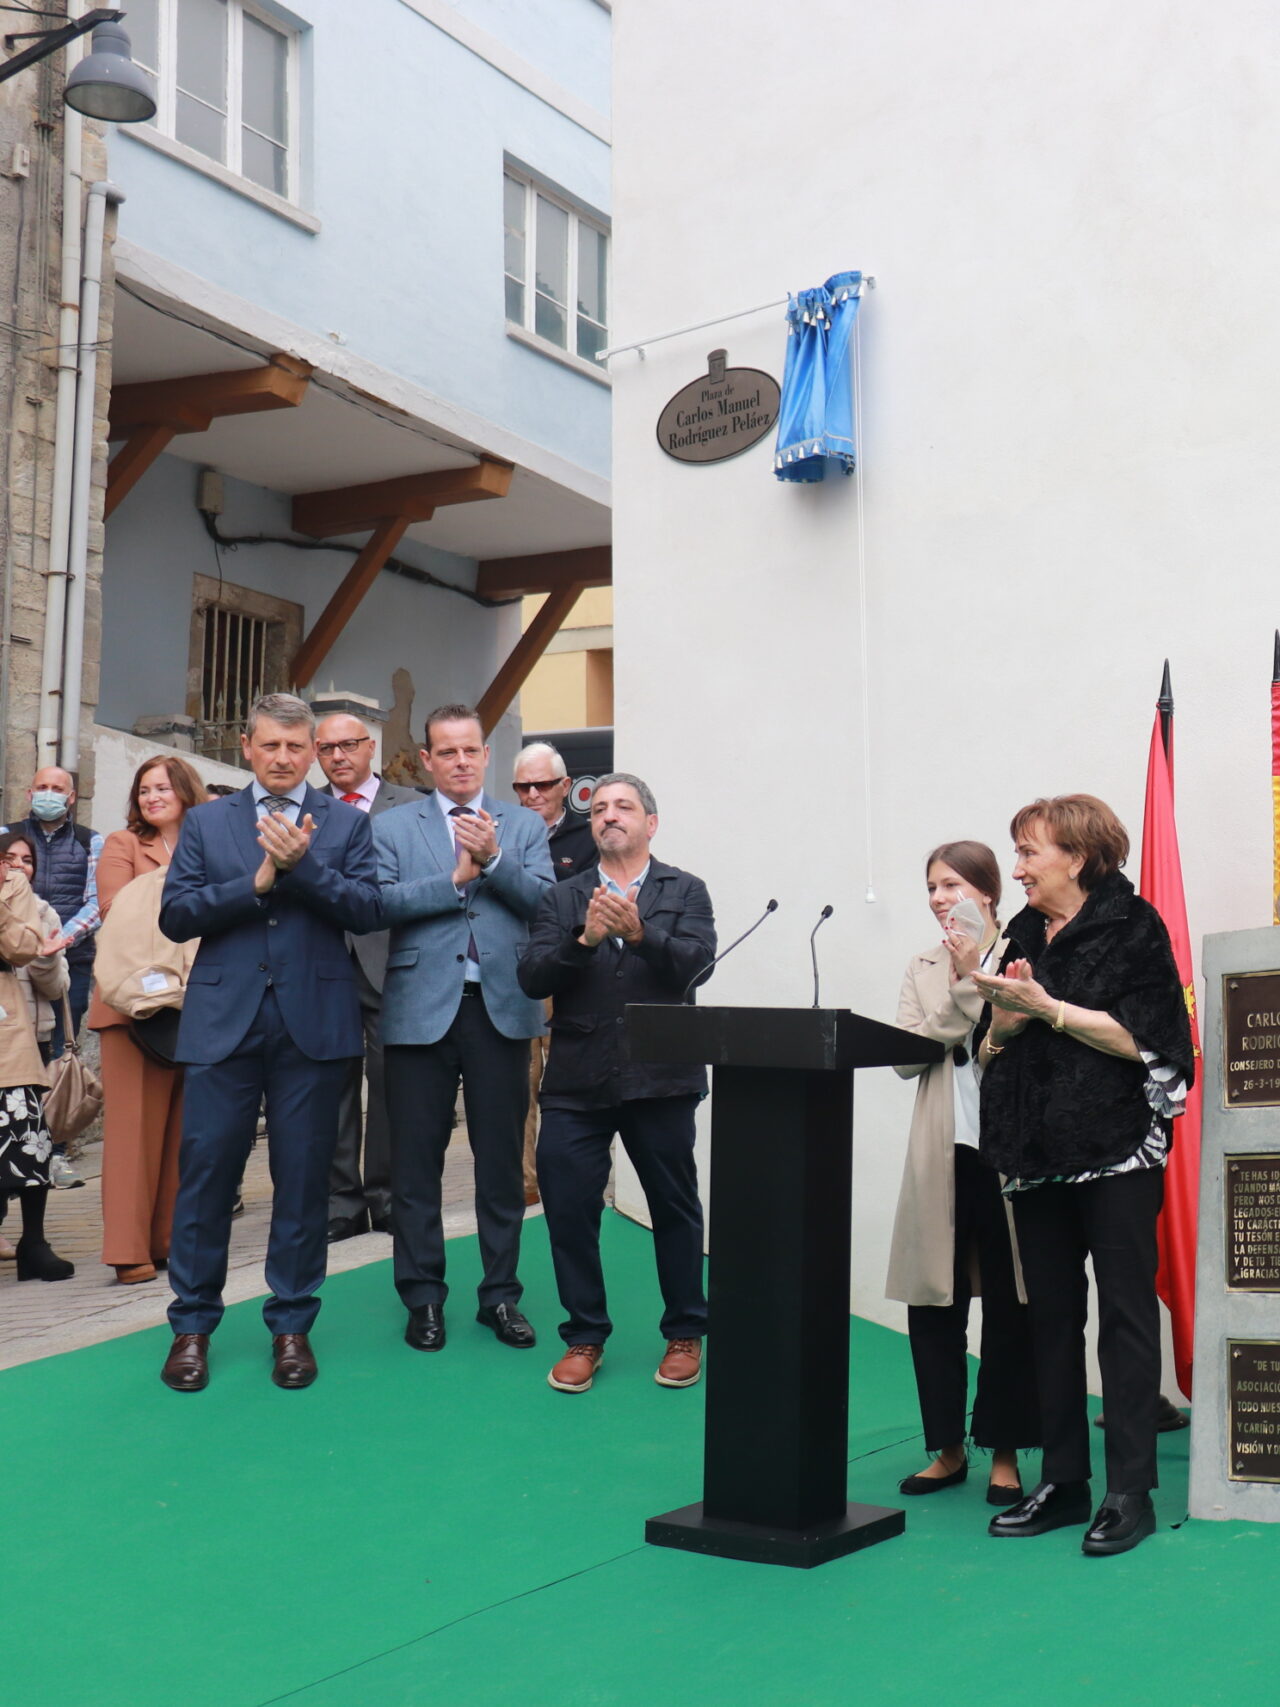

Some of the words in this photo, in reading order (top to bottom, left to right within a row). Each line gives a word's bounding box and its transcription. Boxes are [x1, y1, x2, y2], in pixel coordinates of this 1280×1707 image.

[701, 389, 722, 402] Plaza
[725, 384, 734, 395] de
[676, 406, 713, 428] Carlos
[717, 390, 760, 416] Manuel
[669, 426, 728, 450] Rodríguez
[732, 412, 769, 433] Peláez
[1230, 1060, 1274, 1072] CONSEJERO
[1240, 1171, 1249, 1181] TE
[1251, 1171, 1268, 1181] HAS
[1234, 1182, 1267, 1193] CUANDO
[1234, 1196, 1254, 1206] PERO
[1259, 1196, 1275, 1205] NOS
[1234, 1220, 1244, 1230] TU
[1234, 1232, 1244, 1242] TU
[1247, 1229, 1272, 1242] TESÓN
[1234, 1244, 1245, 1254] LA
[1234, 1257, 1239, 1266] Y
[1243, 1257, 1254, 1266] DE
[1256, 1257, 1265, 1266] TU
[1237, 1402, 1259, 1412] TODO
[1237, 1422, 1242, 1432] Y
[1244, 1420, 1274, 1434] CARIÑO
[1236, 1440, 1263, 1454] VISIÓN
[1267, 1444, 1271, 1454] Y
